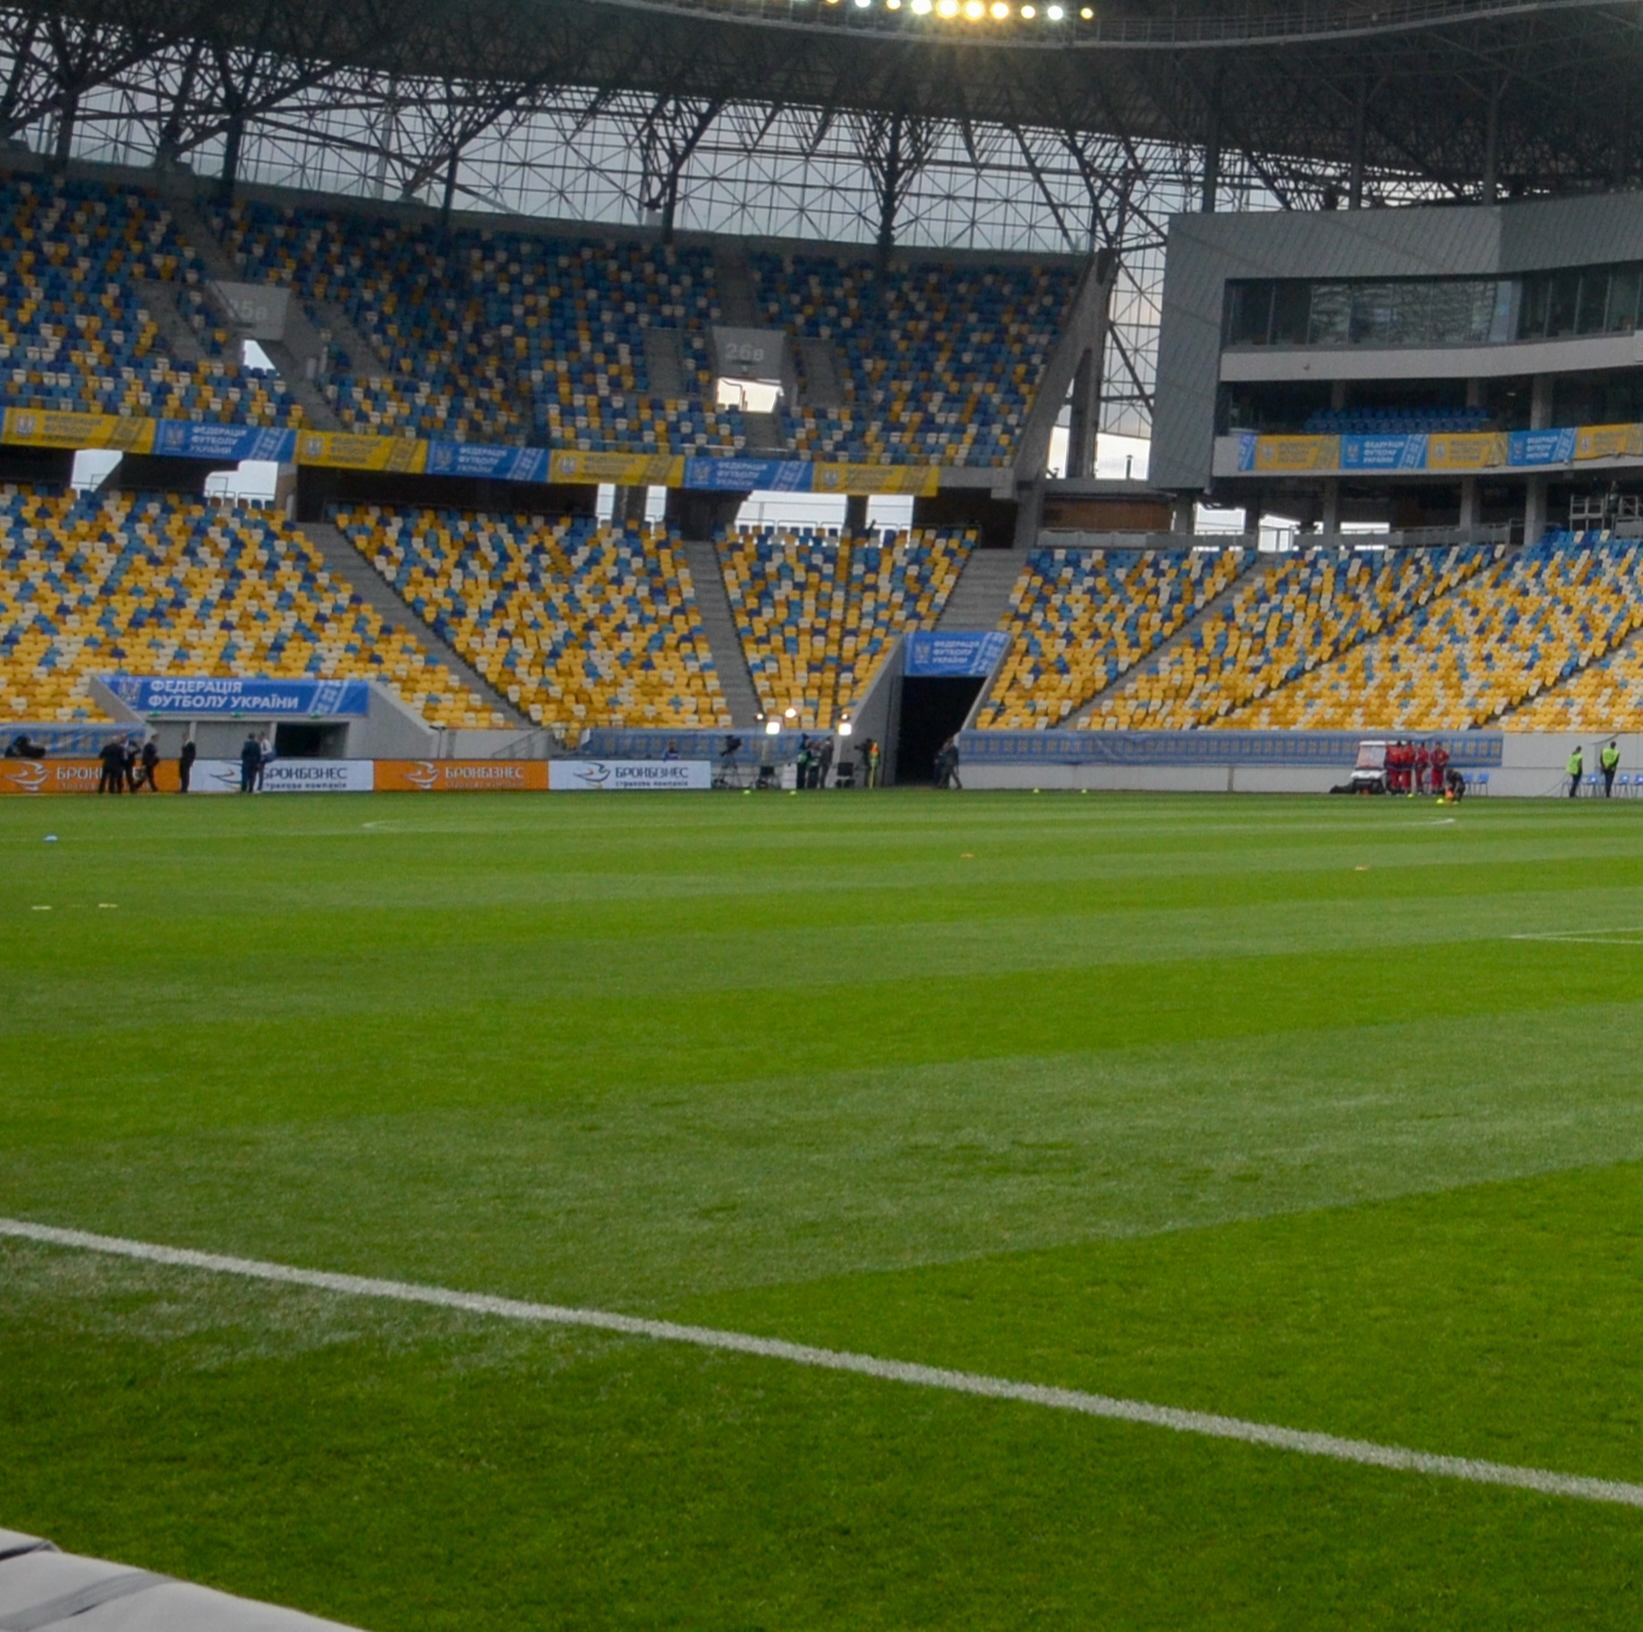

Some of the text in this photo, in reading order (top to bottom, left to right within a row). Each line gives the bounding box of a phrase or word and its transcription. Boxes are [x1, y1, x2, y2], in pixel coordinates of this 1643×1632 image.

[150, 679, 242, 694] ФЕДЕРАЦІЯ
[149, 694, 299, 709] ФУТБОЛУ УКРАЇНИ
